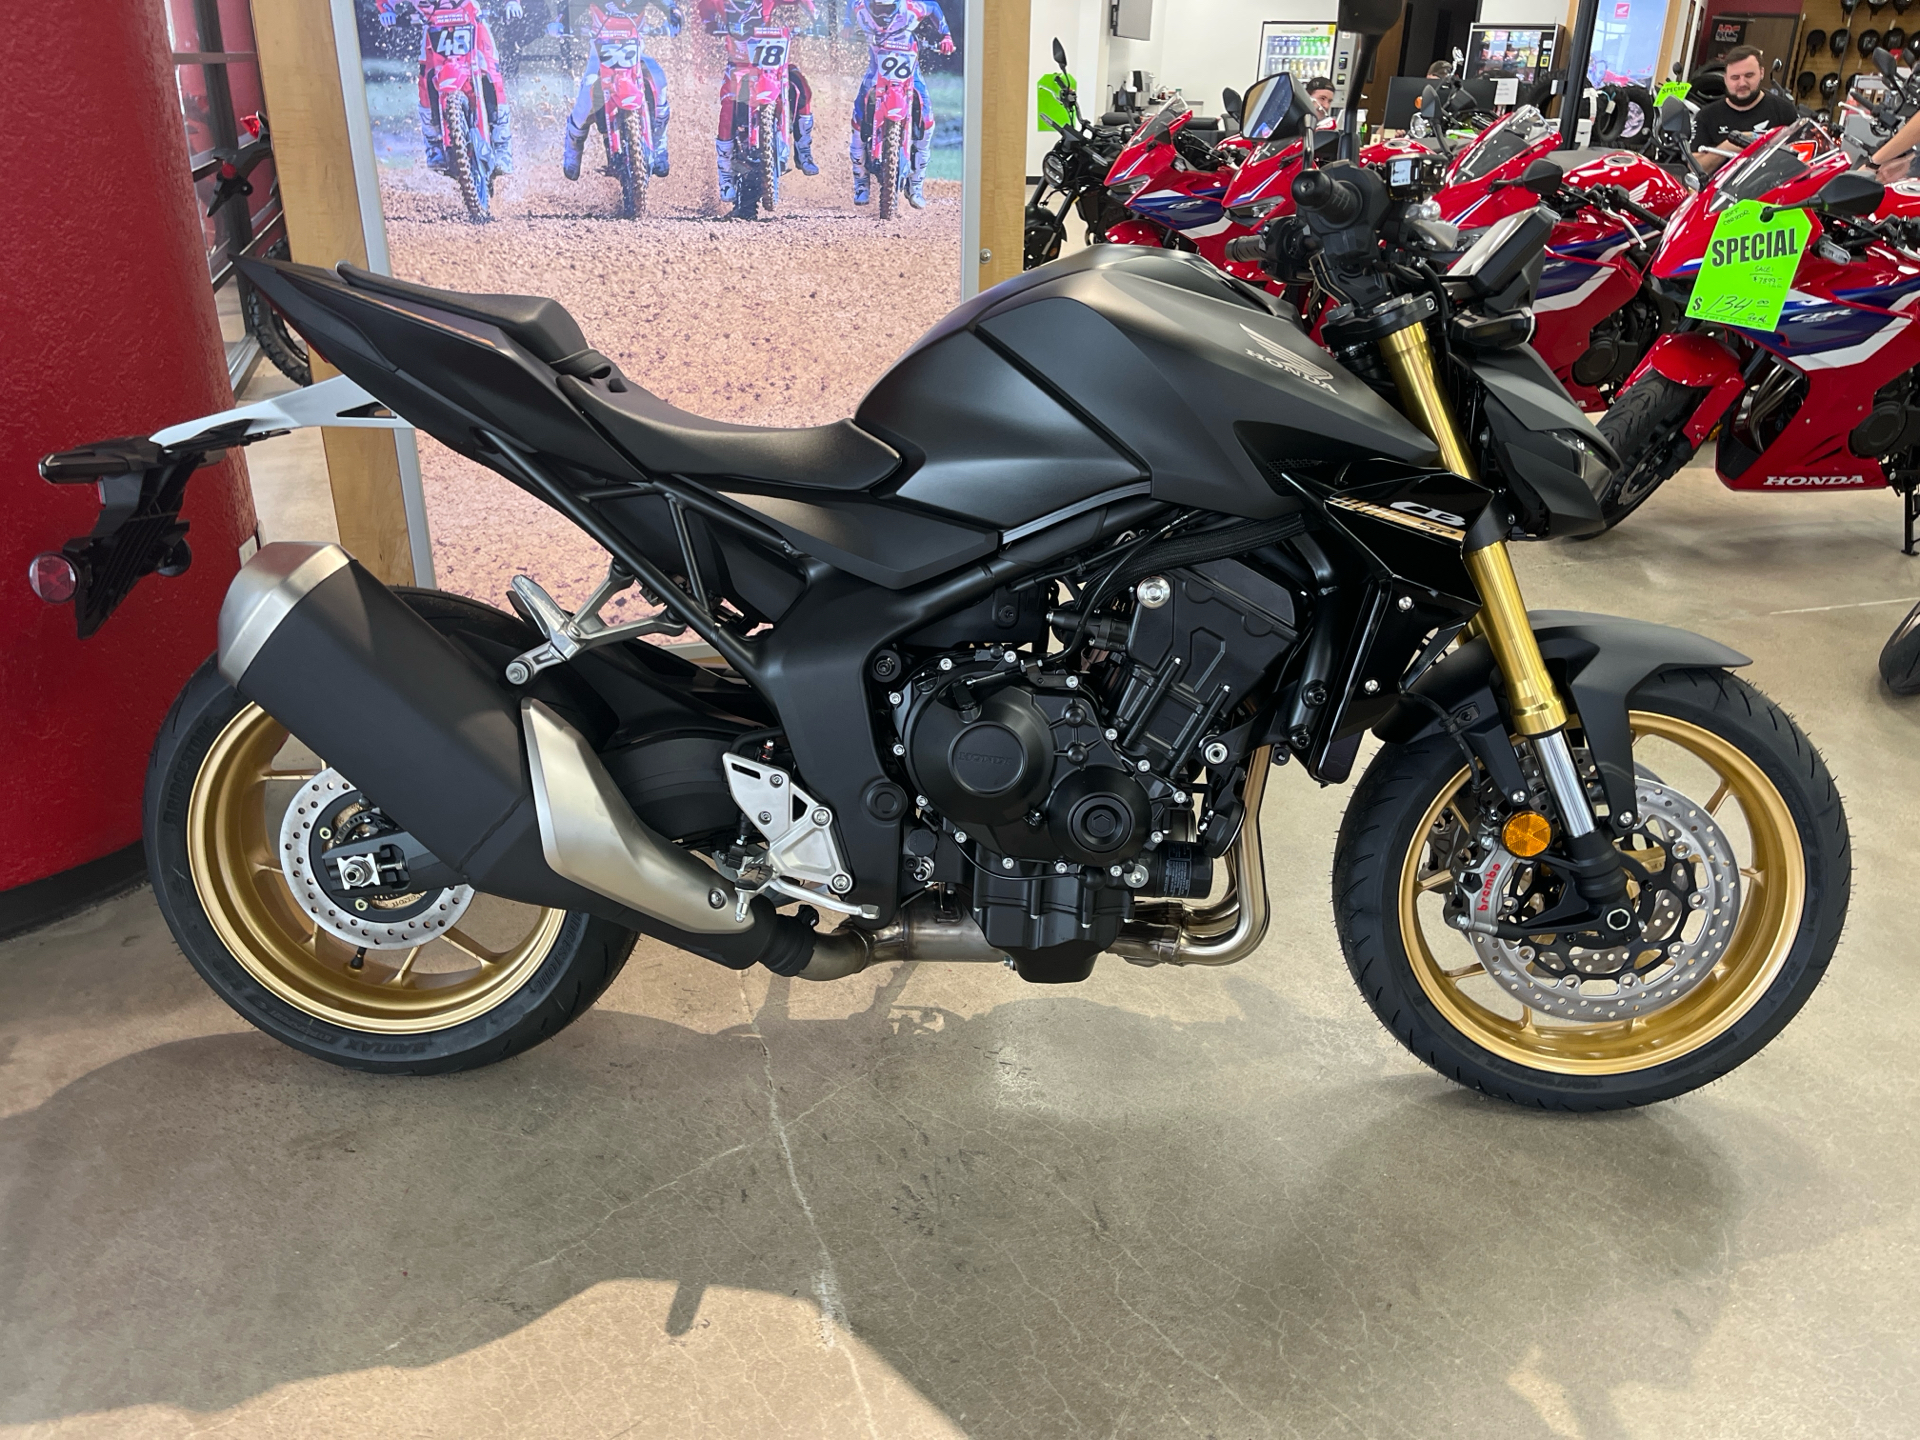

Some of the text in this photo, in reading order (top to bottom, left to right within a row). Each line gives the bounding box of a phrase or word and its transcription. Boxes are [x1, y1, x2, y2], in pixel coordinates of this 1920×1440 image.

[437, 30, 471, 56] 48
[752, 45, 785, 67] 18
[881, 57, 911, 79] 96
[1711, 228, 1798, 268] SPECIAL
[1244, 347, 1339, 395] HONDA
[1762, 474, 1865, 486] HONDA
[1389, 501, 1466, 527] CB
[1477, 863, 1502, 911] brembo
